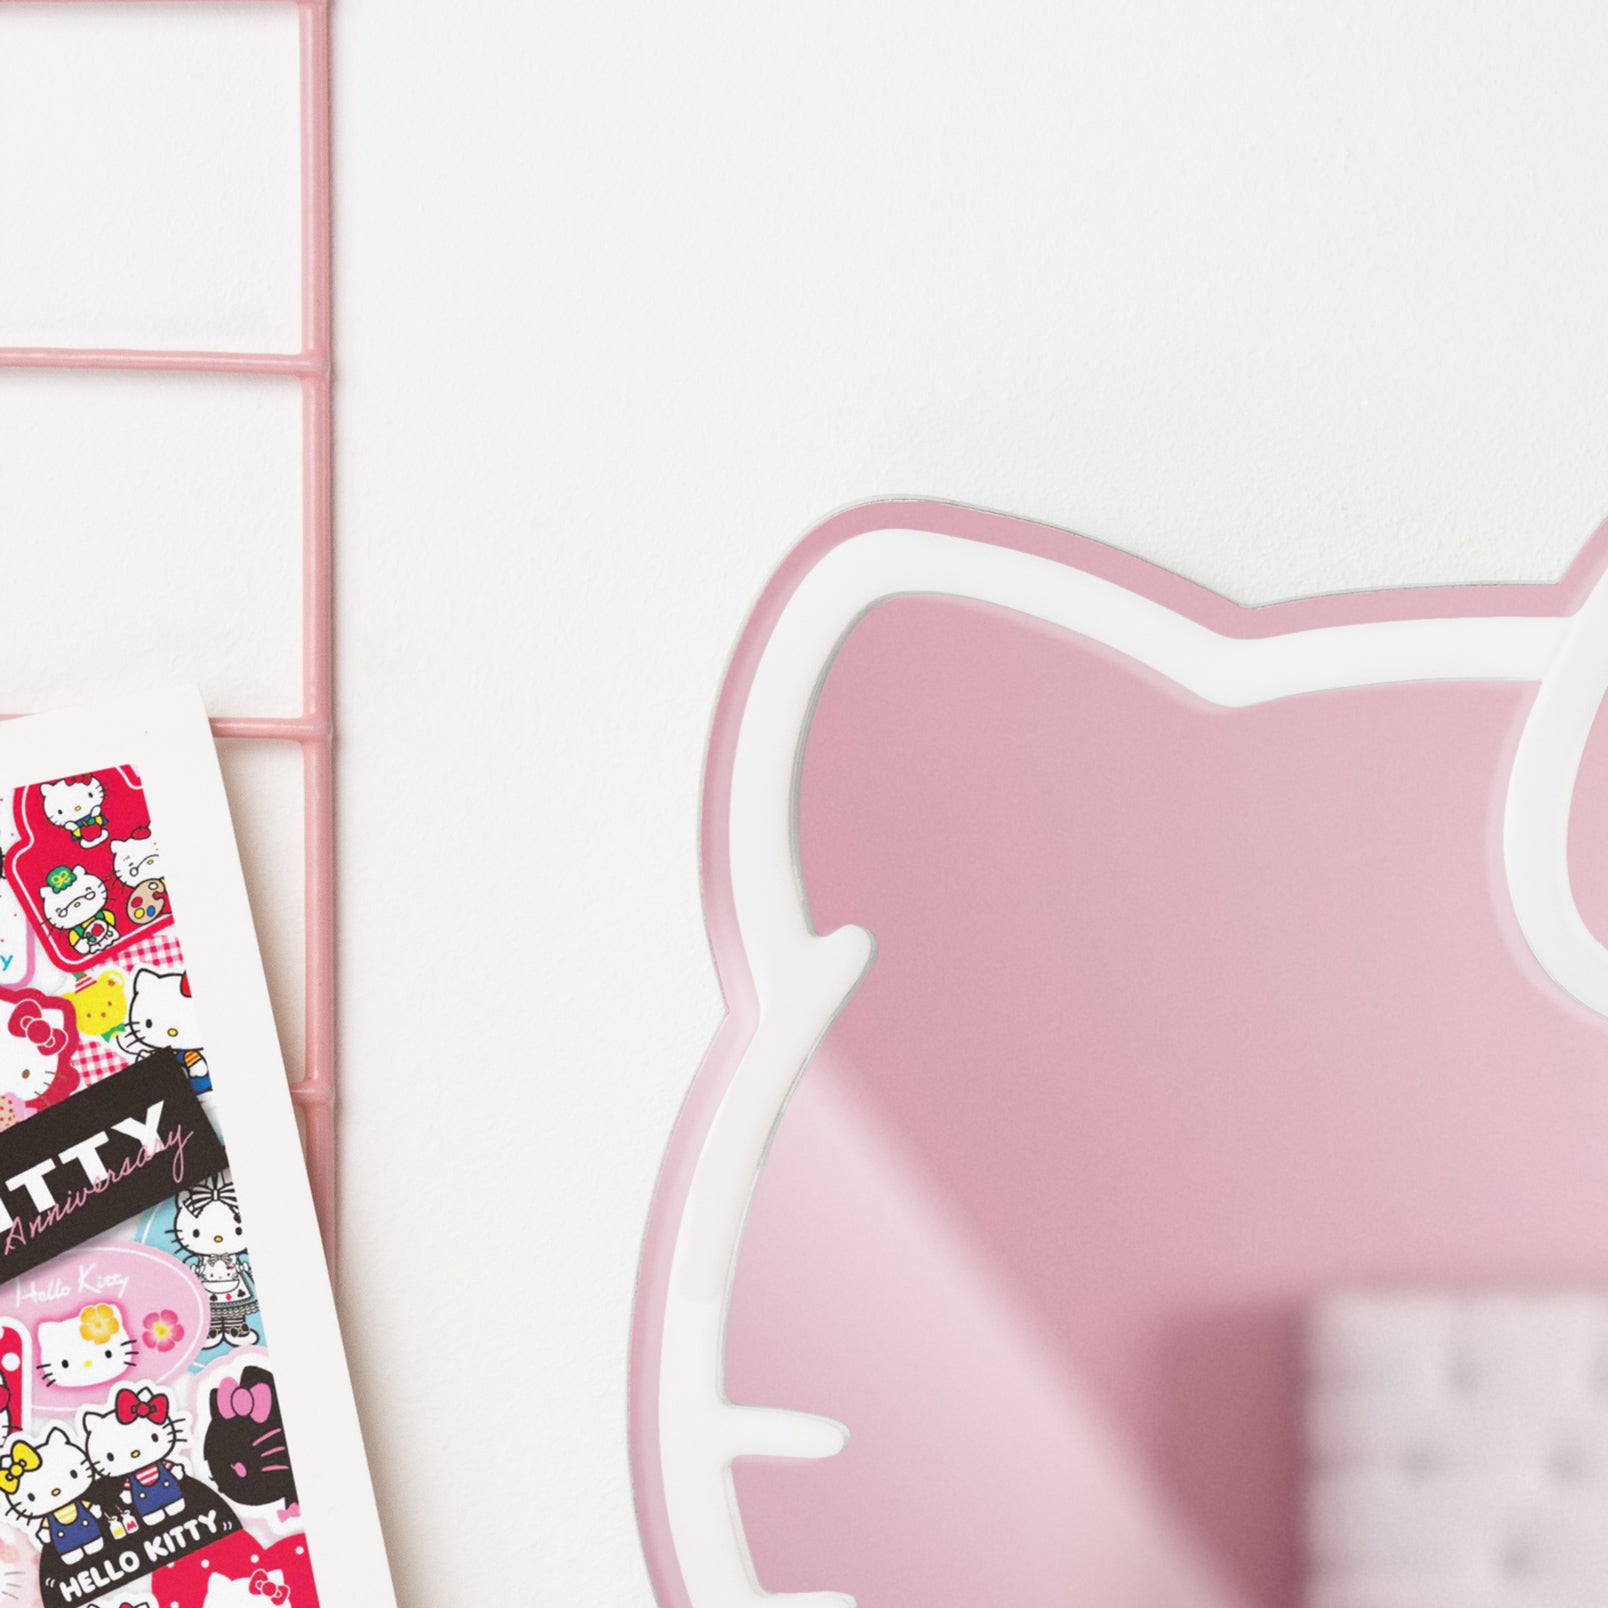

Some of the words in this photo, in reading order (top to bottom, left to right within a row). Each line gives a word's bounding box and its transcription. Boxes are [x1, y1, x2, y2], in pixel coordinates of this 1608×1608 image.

[0, 1100, 164, 1233] TTY
[4, 1124, 194, 1255] Anniversary
[16, 1279, 72, 1308] Hello
[59, 1551, 140, 1602] HELLO
[143, 1509, 217, 1562] KITTY
